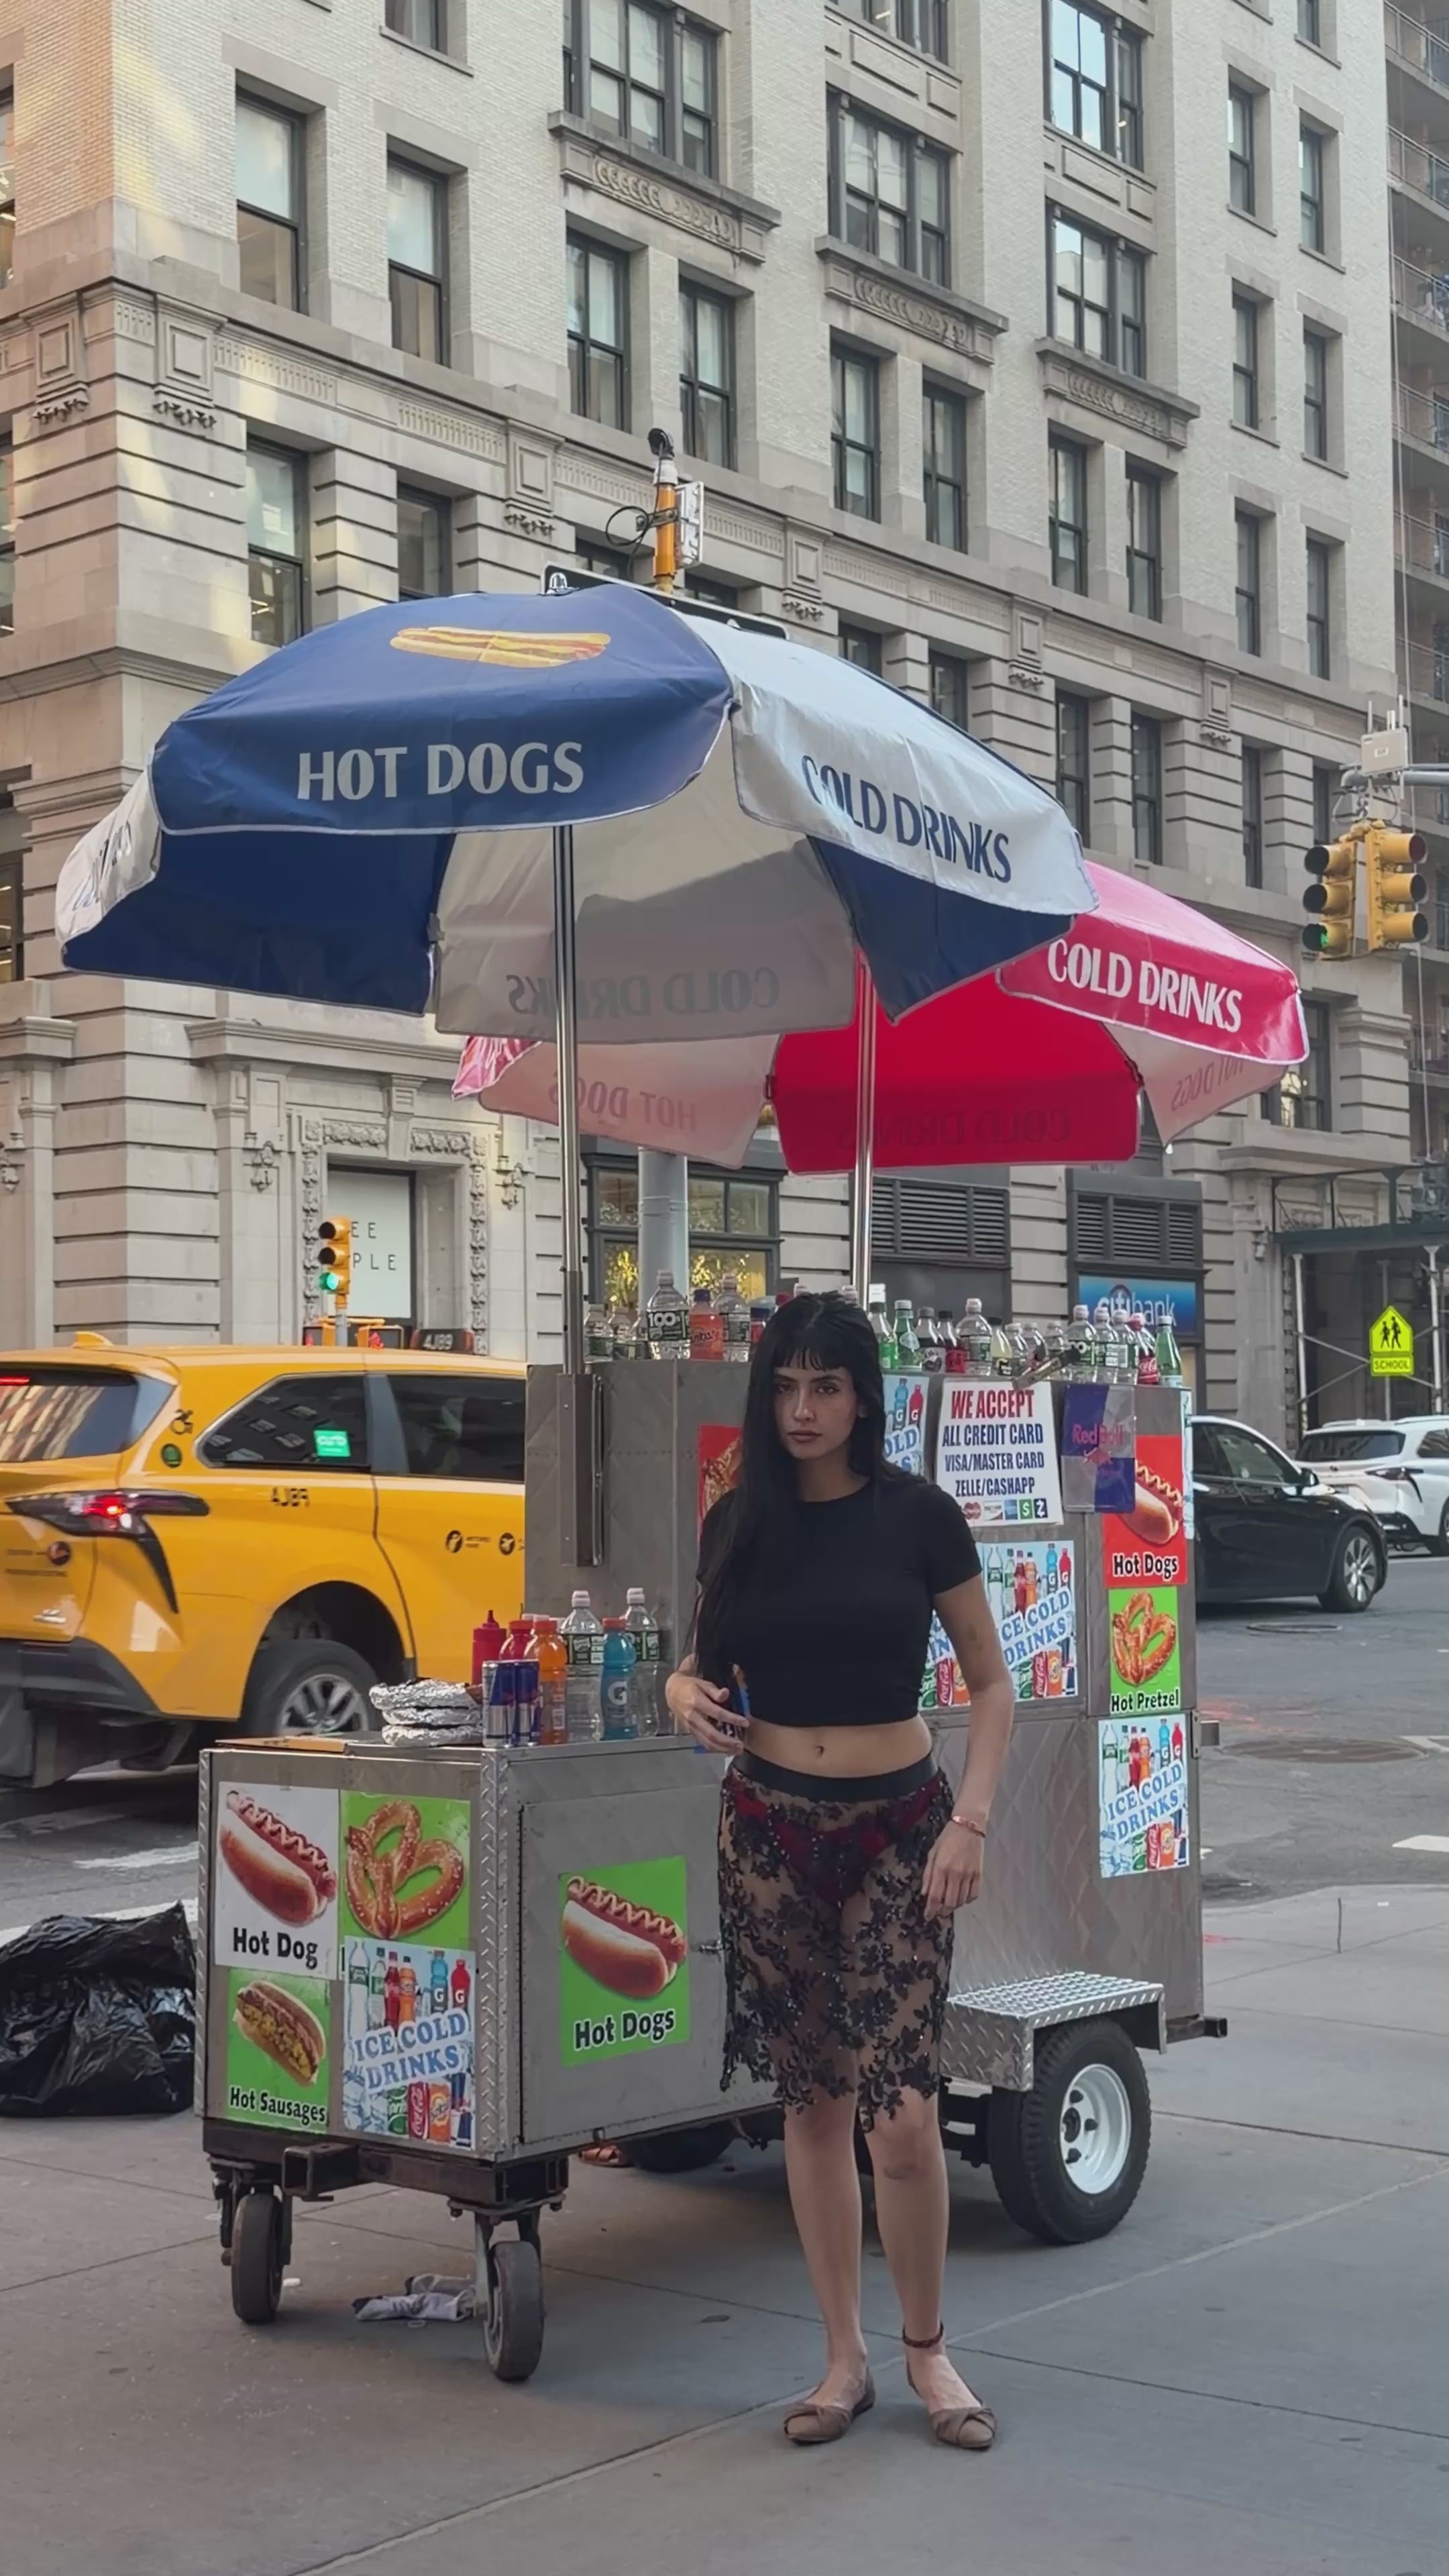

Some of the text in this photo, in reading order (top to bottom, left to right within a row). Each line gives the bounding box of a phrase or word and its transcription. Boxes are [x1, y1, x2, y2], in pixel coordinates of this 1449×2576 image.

[297, 741, 584, 801] HOT DOGS
[802, 755, 1011, 883] COLD DRINKS
[1048, 939, 1242, 1032] COLD DRINKS
[351, 1221, 377, 1238] EE
[353, 1252, 397, 1271] PLE
[1374, 1360, 1409, 1370] SCHOOL
[951, 1389, 1034, 1419] WE ACCEPT
[884, 1428, 918, 1457] OLD
[942, 1423, 1044, 1447] ALL CREDIT CARD
[1073, 1423, 1098, 1444] Red
[945, 1452, 1044, 1472] VISA/MASTER CARD
[955, 1477, 1035, 1497] ZELLE/CASHAPP
[1113, 1553, 1177, 1580] Hot Dogs
[1000, 1591, 1070, 1642] CE COLD
[1004, 1617, 1067, 1665] DRINKS
[607, 1681, 627, 1705] G
[1111, 1688, 1179, 1712] Hot Pretzel
[1108, 1764, 1182, 1821] ICE COLD
[1117, 1789, 1179, 1841] DRINKS
[233, 1927, 318, 1970] Hot Dog
[354, 2012, 466, 2061] ICE COLD
[574, 2009, 675, 2049] Hot Dogs
[366, 2045, 460, 2089] DRINKS
[229, 2086, 326, 2126] Hot Sausages
